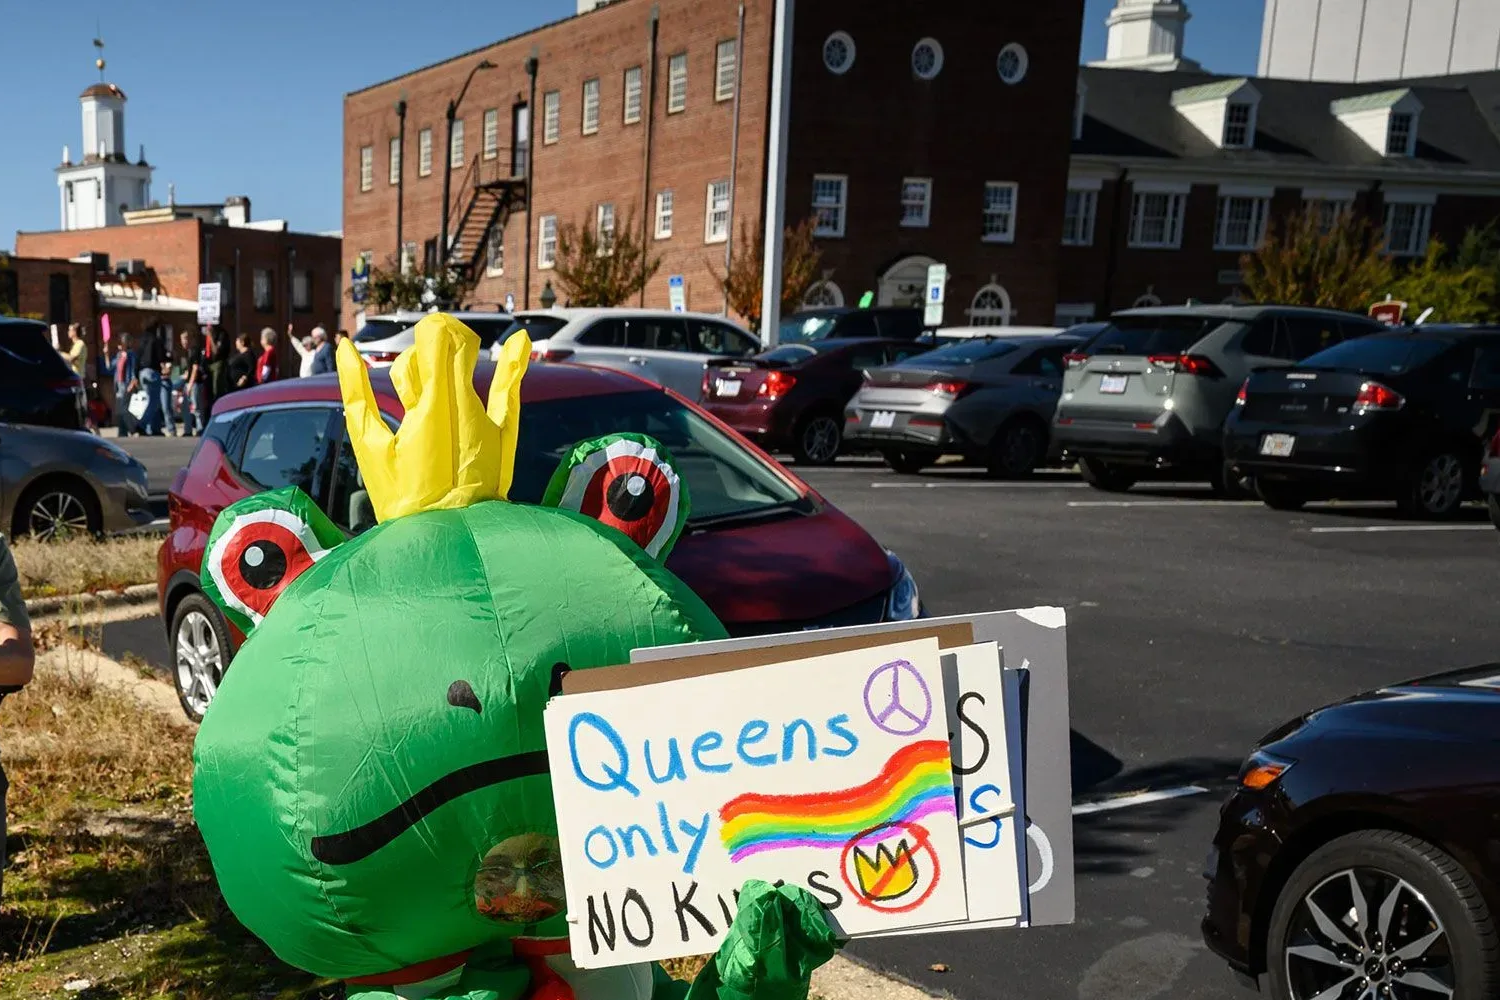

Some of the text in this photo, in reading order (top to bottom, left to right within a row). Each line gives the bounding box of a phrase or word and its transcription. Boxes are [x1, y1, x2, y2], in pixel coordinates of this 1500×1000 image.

[568, 711, 860, 797] Queens
[583, 800, 710, 875] only
[586, 870, 843, 956] NO KIS
